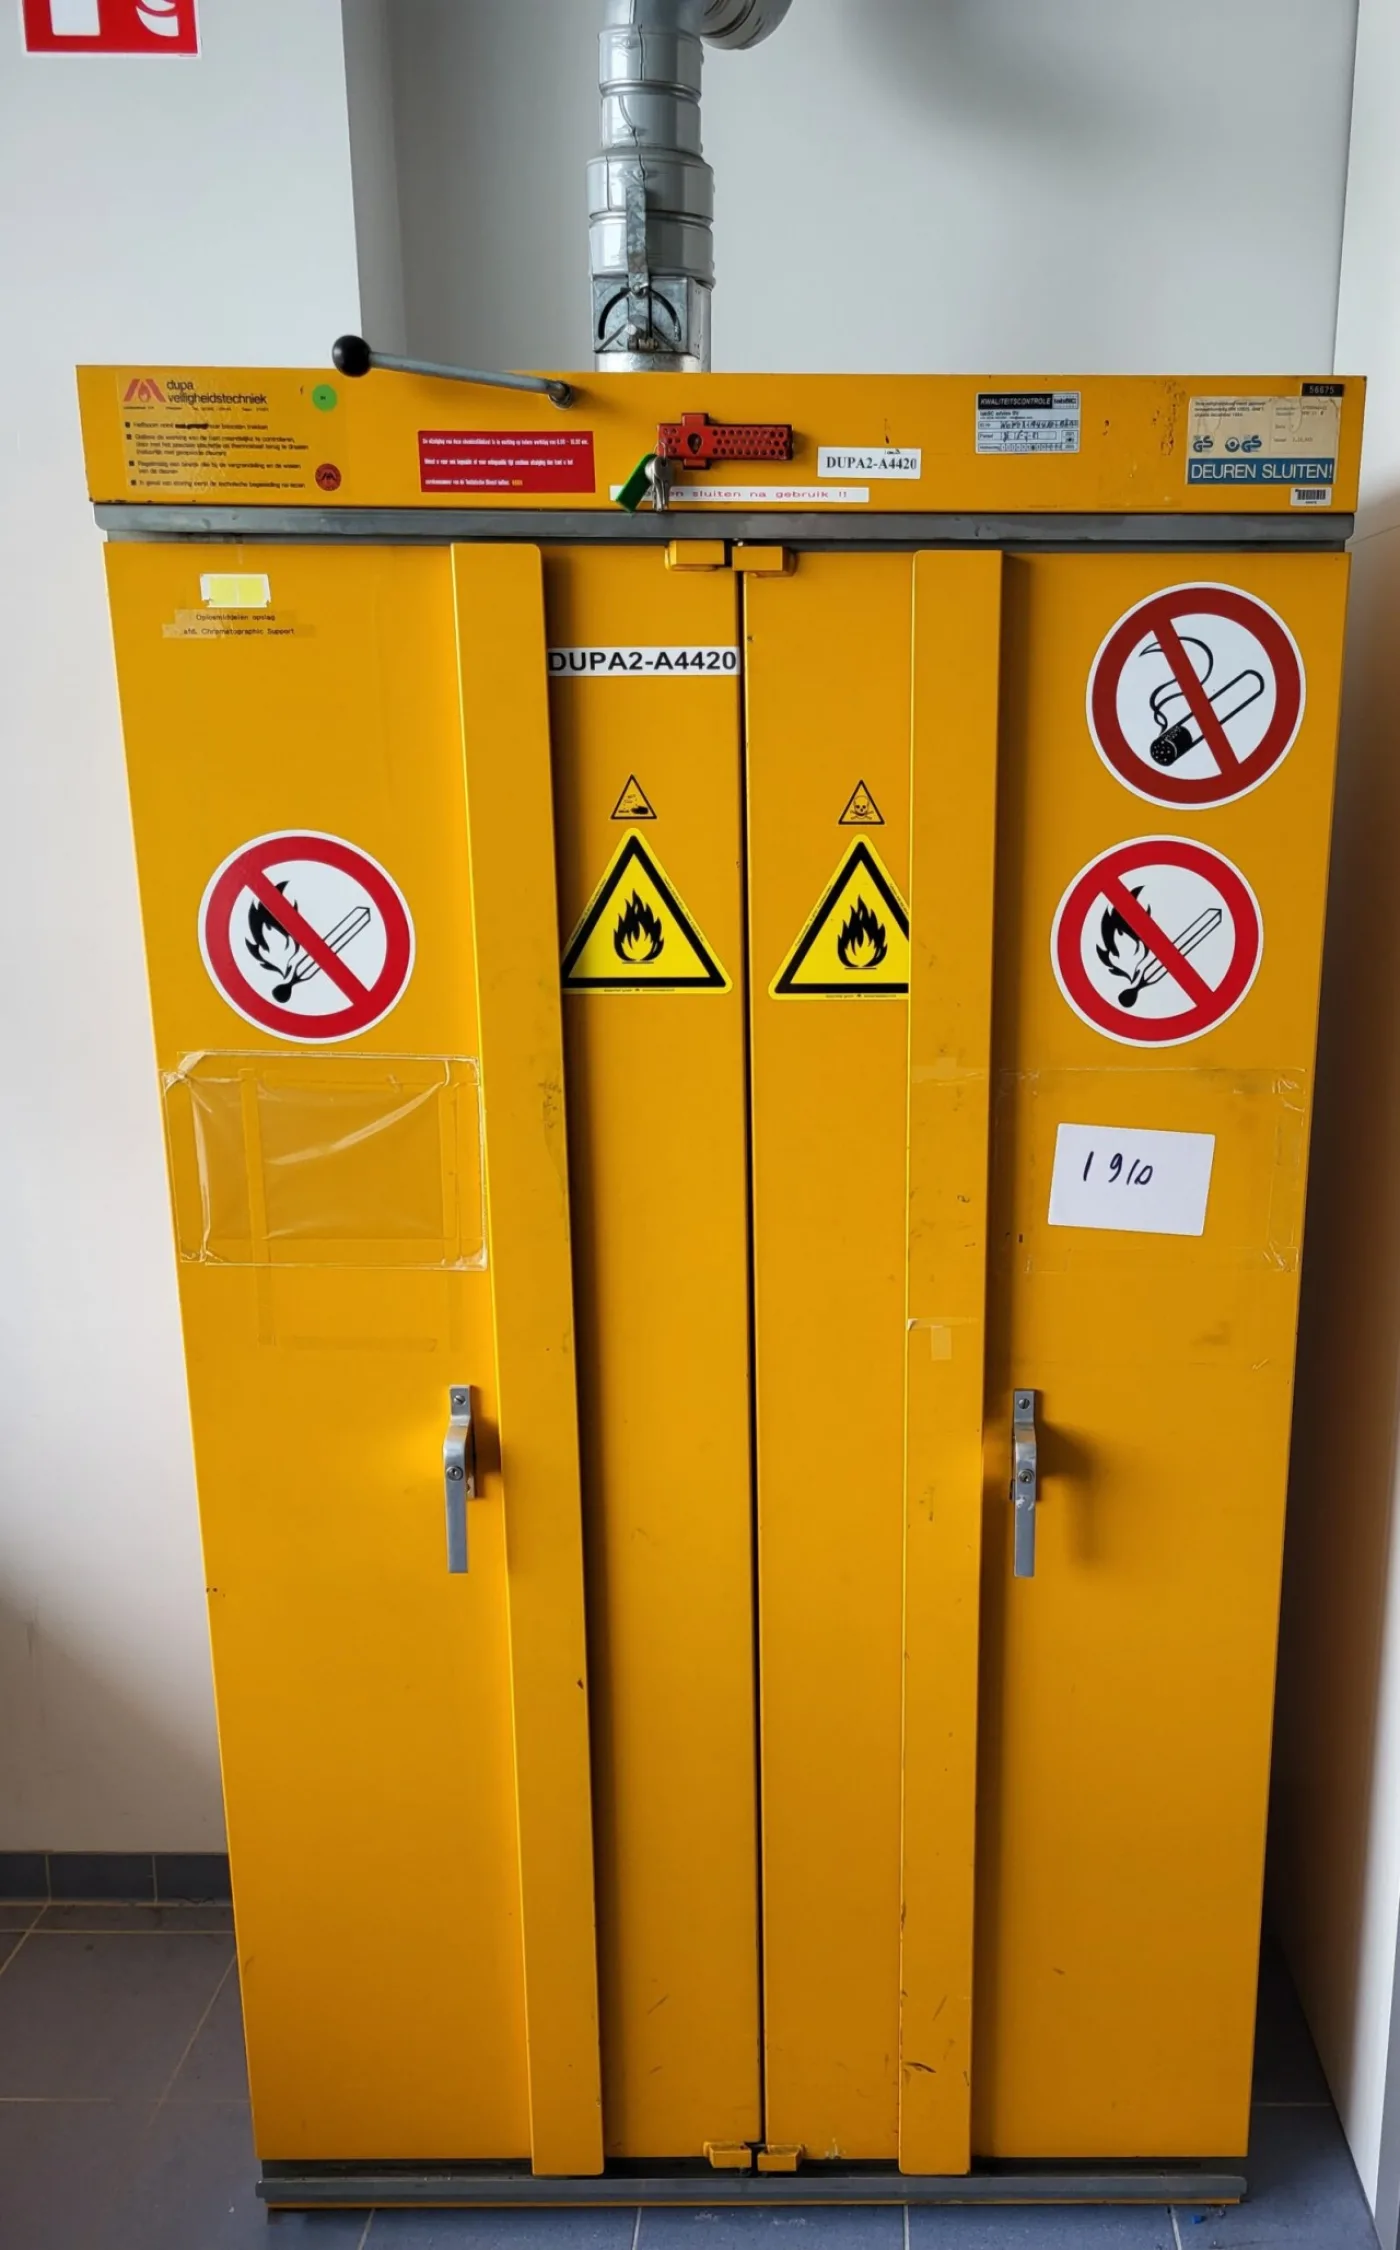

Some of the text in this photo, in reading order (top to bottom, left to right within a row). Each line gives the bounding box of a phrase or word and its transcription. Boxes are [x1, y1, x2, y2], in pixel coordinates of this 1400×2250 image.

[166, 379, 194, 392] dupa
[167, 392, 267, 405] veiligheidstechniek
[980, 397, 1051, 406] KWALITEITSCONTROLE
[826, 456, 917, 470] DUPA2-A4420
[1191, 463, 1333, 479] DEUREN SLUITEN!
[692, 489, 741, 498] sluiten
[775, 490, 829, 499] gebruik
[267, 628, 295, 636] Support
[549, 651, 737, 671] DUPA2-A4420
